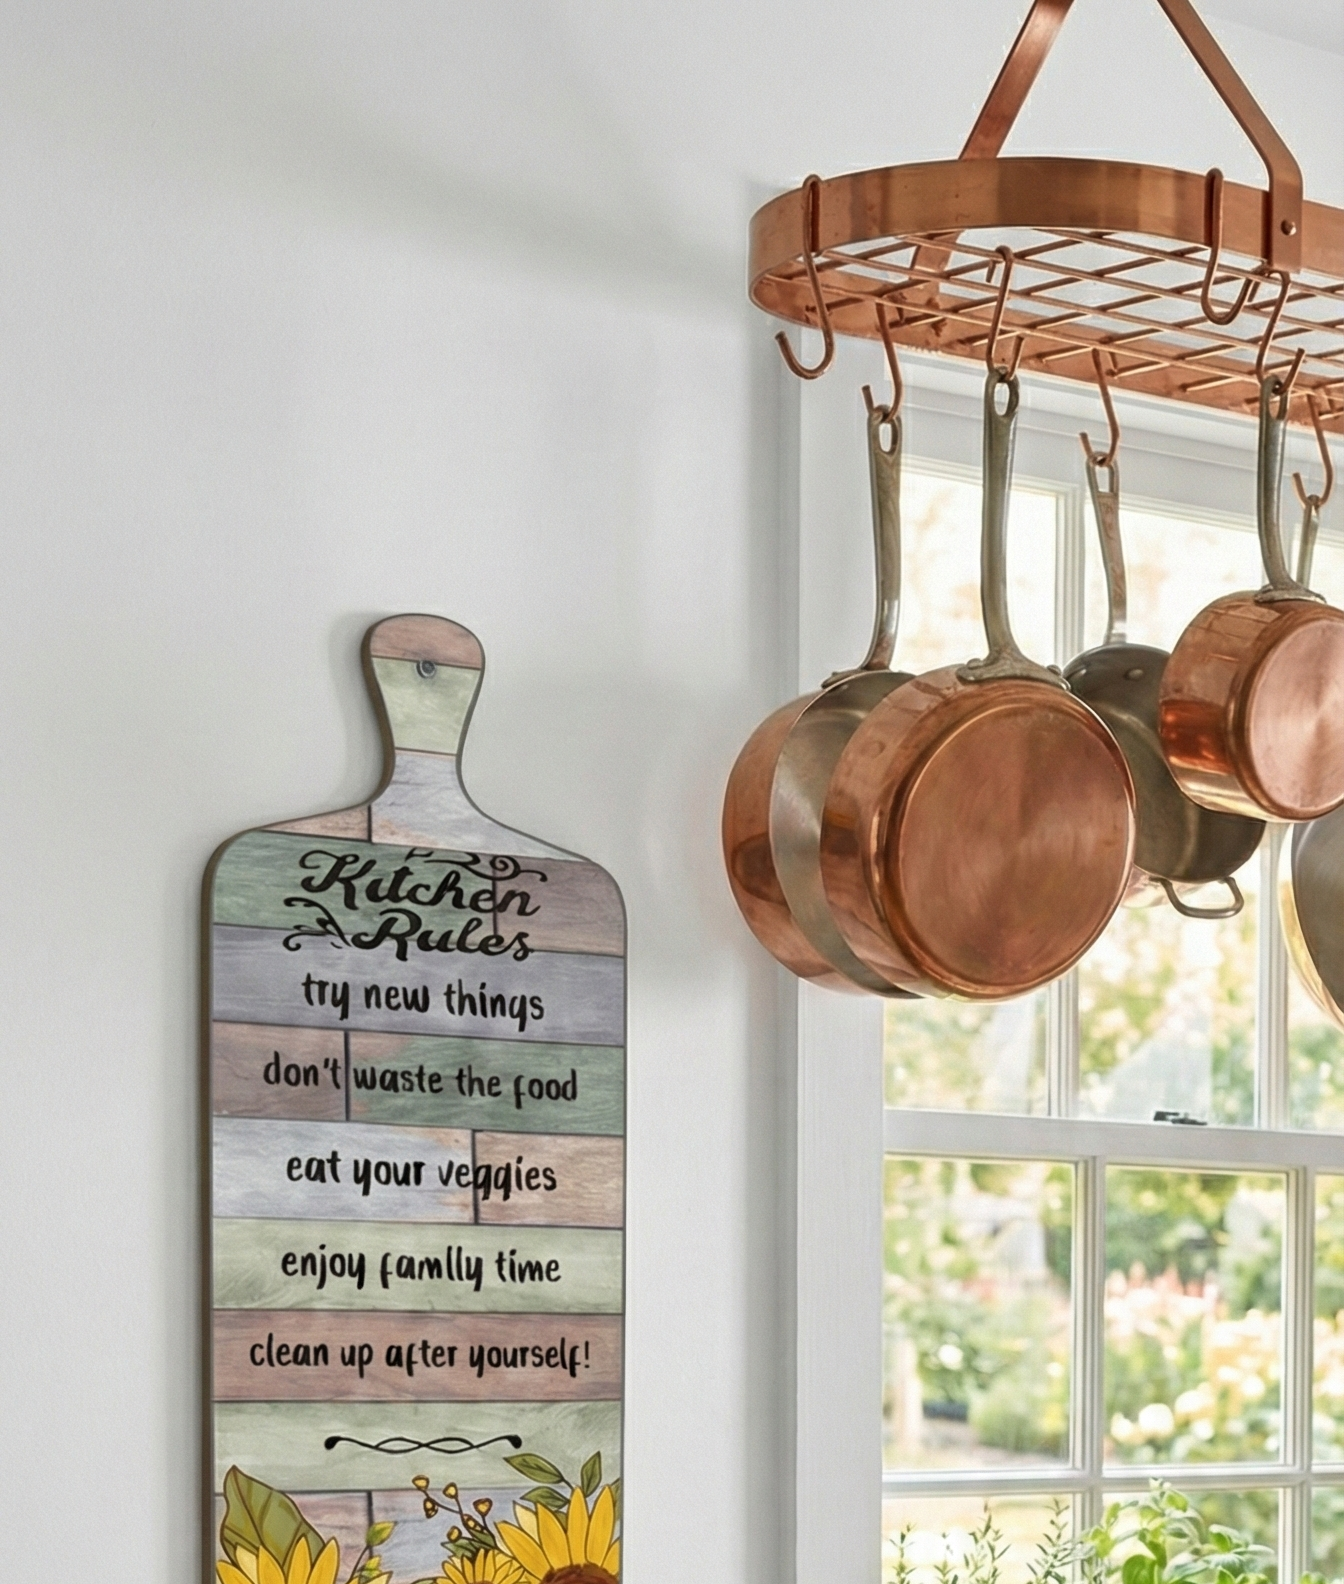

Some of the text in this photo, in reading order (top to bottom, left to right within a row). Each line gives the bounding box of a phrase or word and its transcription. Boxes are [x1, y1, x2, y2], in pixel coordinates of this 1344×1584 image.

[299, 849, 541, 917] Kitchen
[351, 907, 535, 961] Rules
[302, 973, 545, 1032] try new things
[263, 1051, 578, 1109] don't waste the food
[286, 1151, 558, 1202] eat your veggies
[281, 1244, 366, 1290] enjoy
[496, 1249, 562, 1283] time
[249, 1333, 591, 1378] clean up after yourself!
